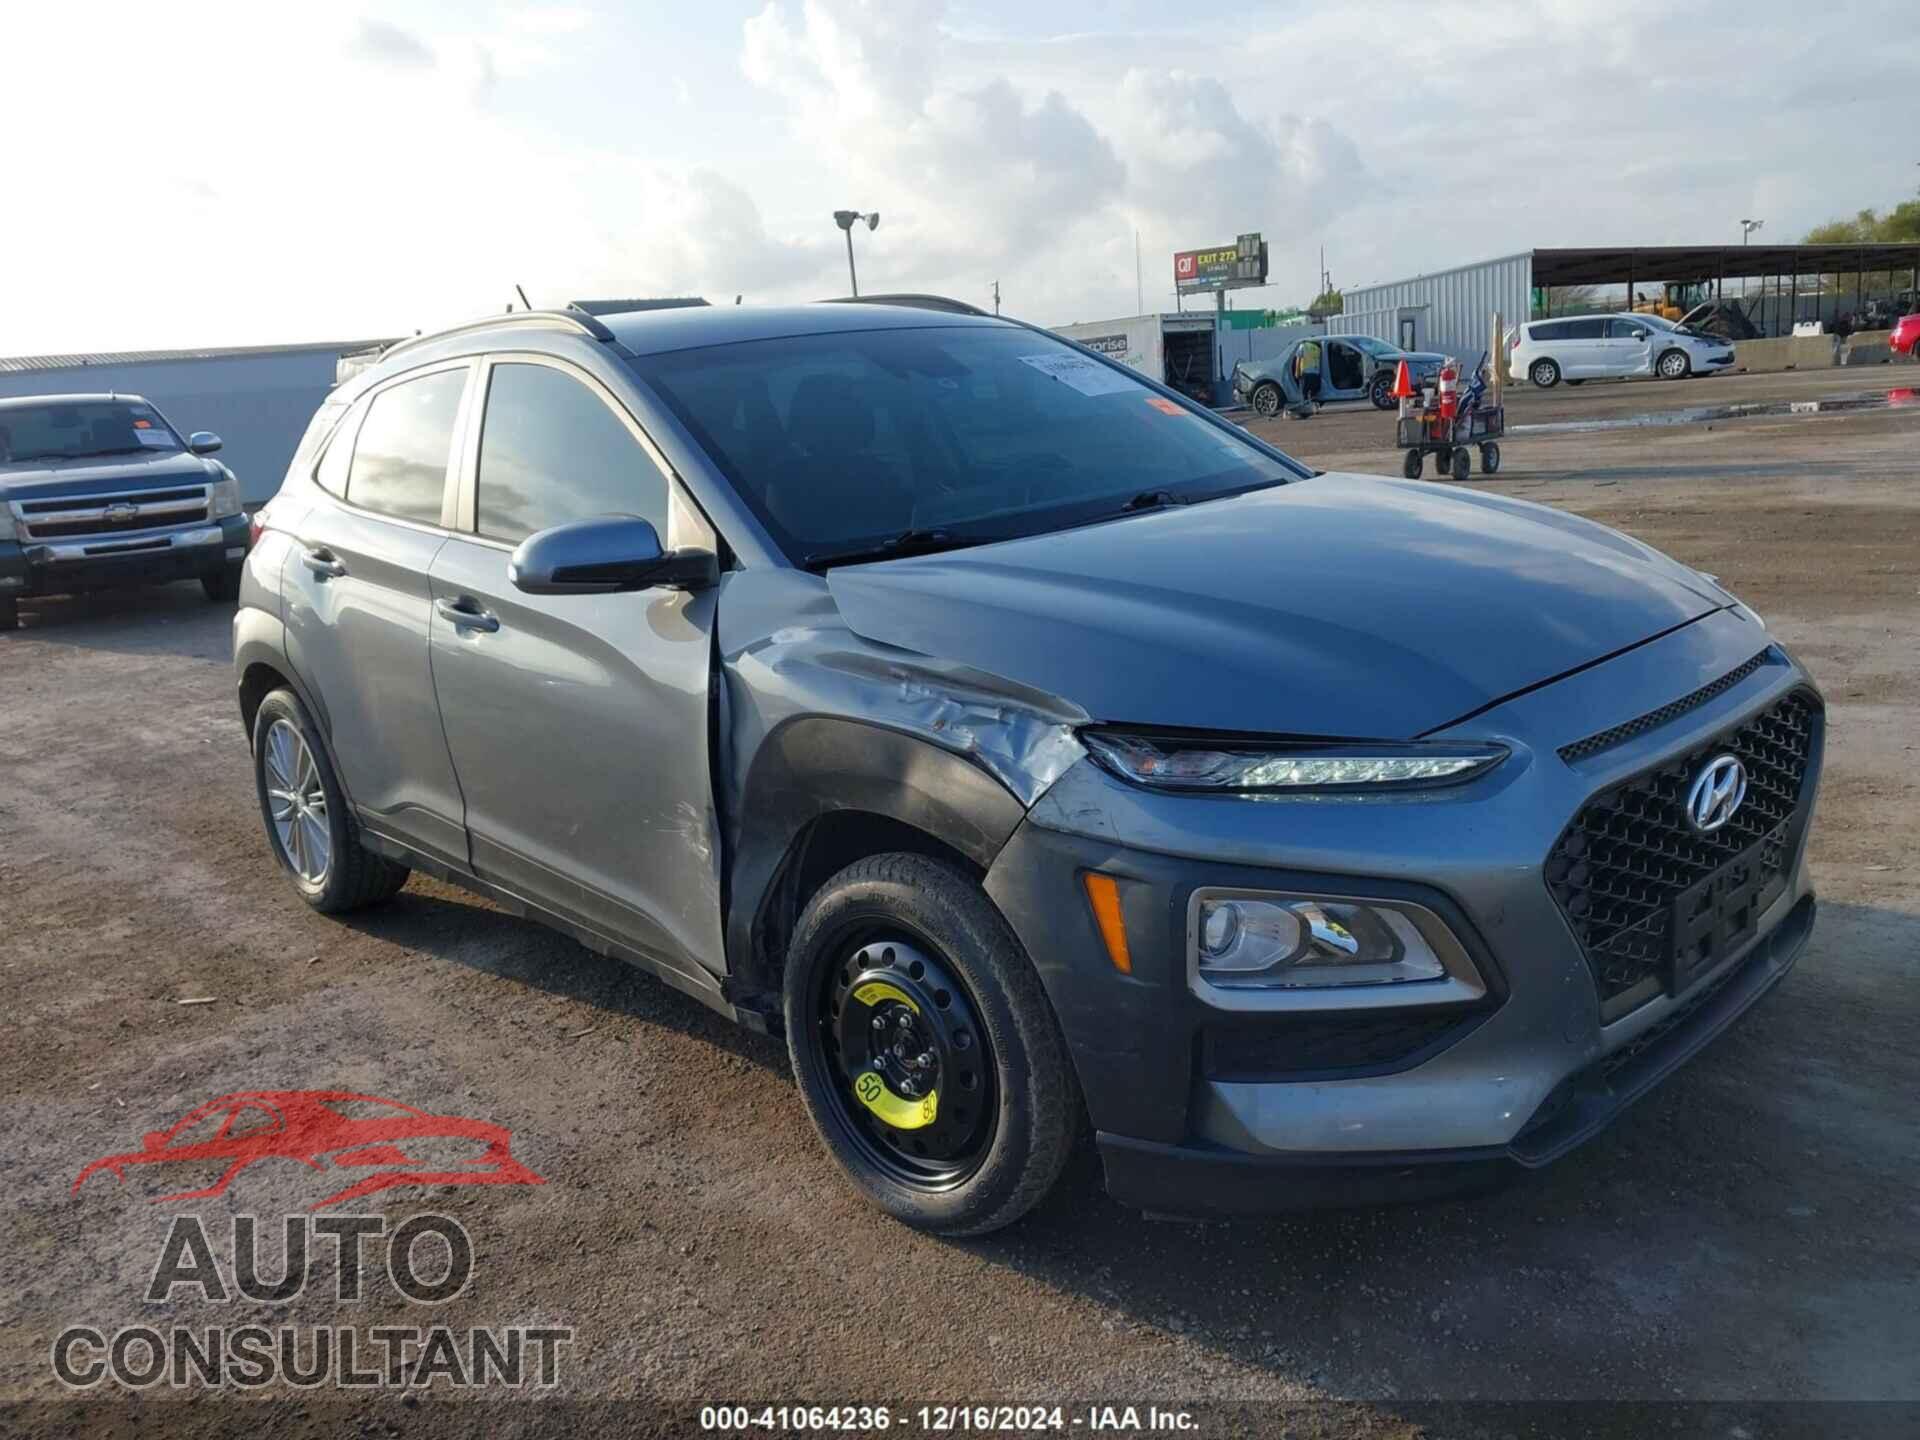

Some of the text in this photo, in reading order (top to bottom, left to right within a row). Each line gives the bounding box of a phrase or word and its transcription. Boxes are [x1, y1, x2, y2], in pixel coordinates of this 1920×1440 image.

[1178, 257, 1193, 273] QT
[1198, 250, 1237, 264] EXIT 273
[857, 1074, 882, 1103] 50
